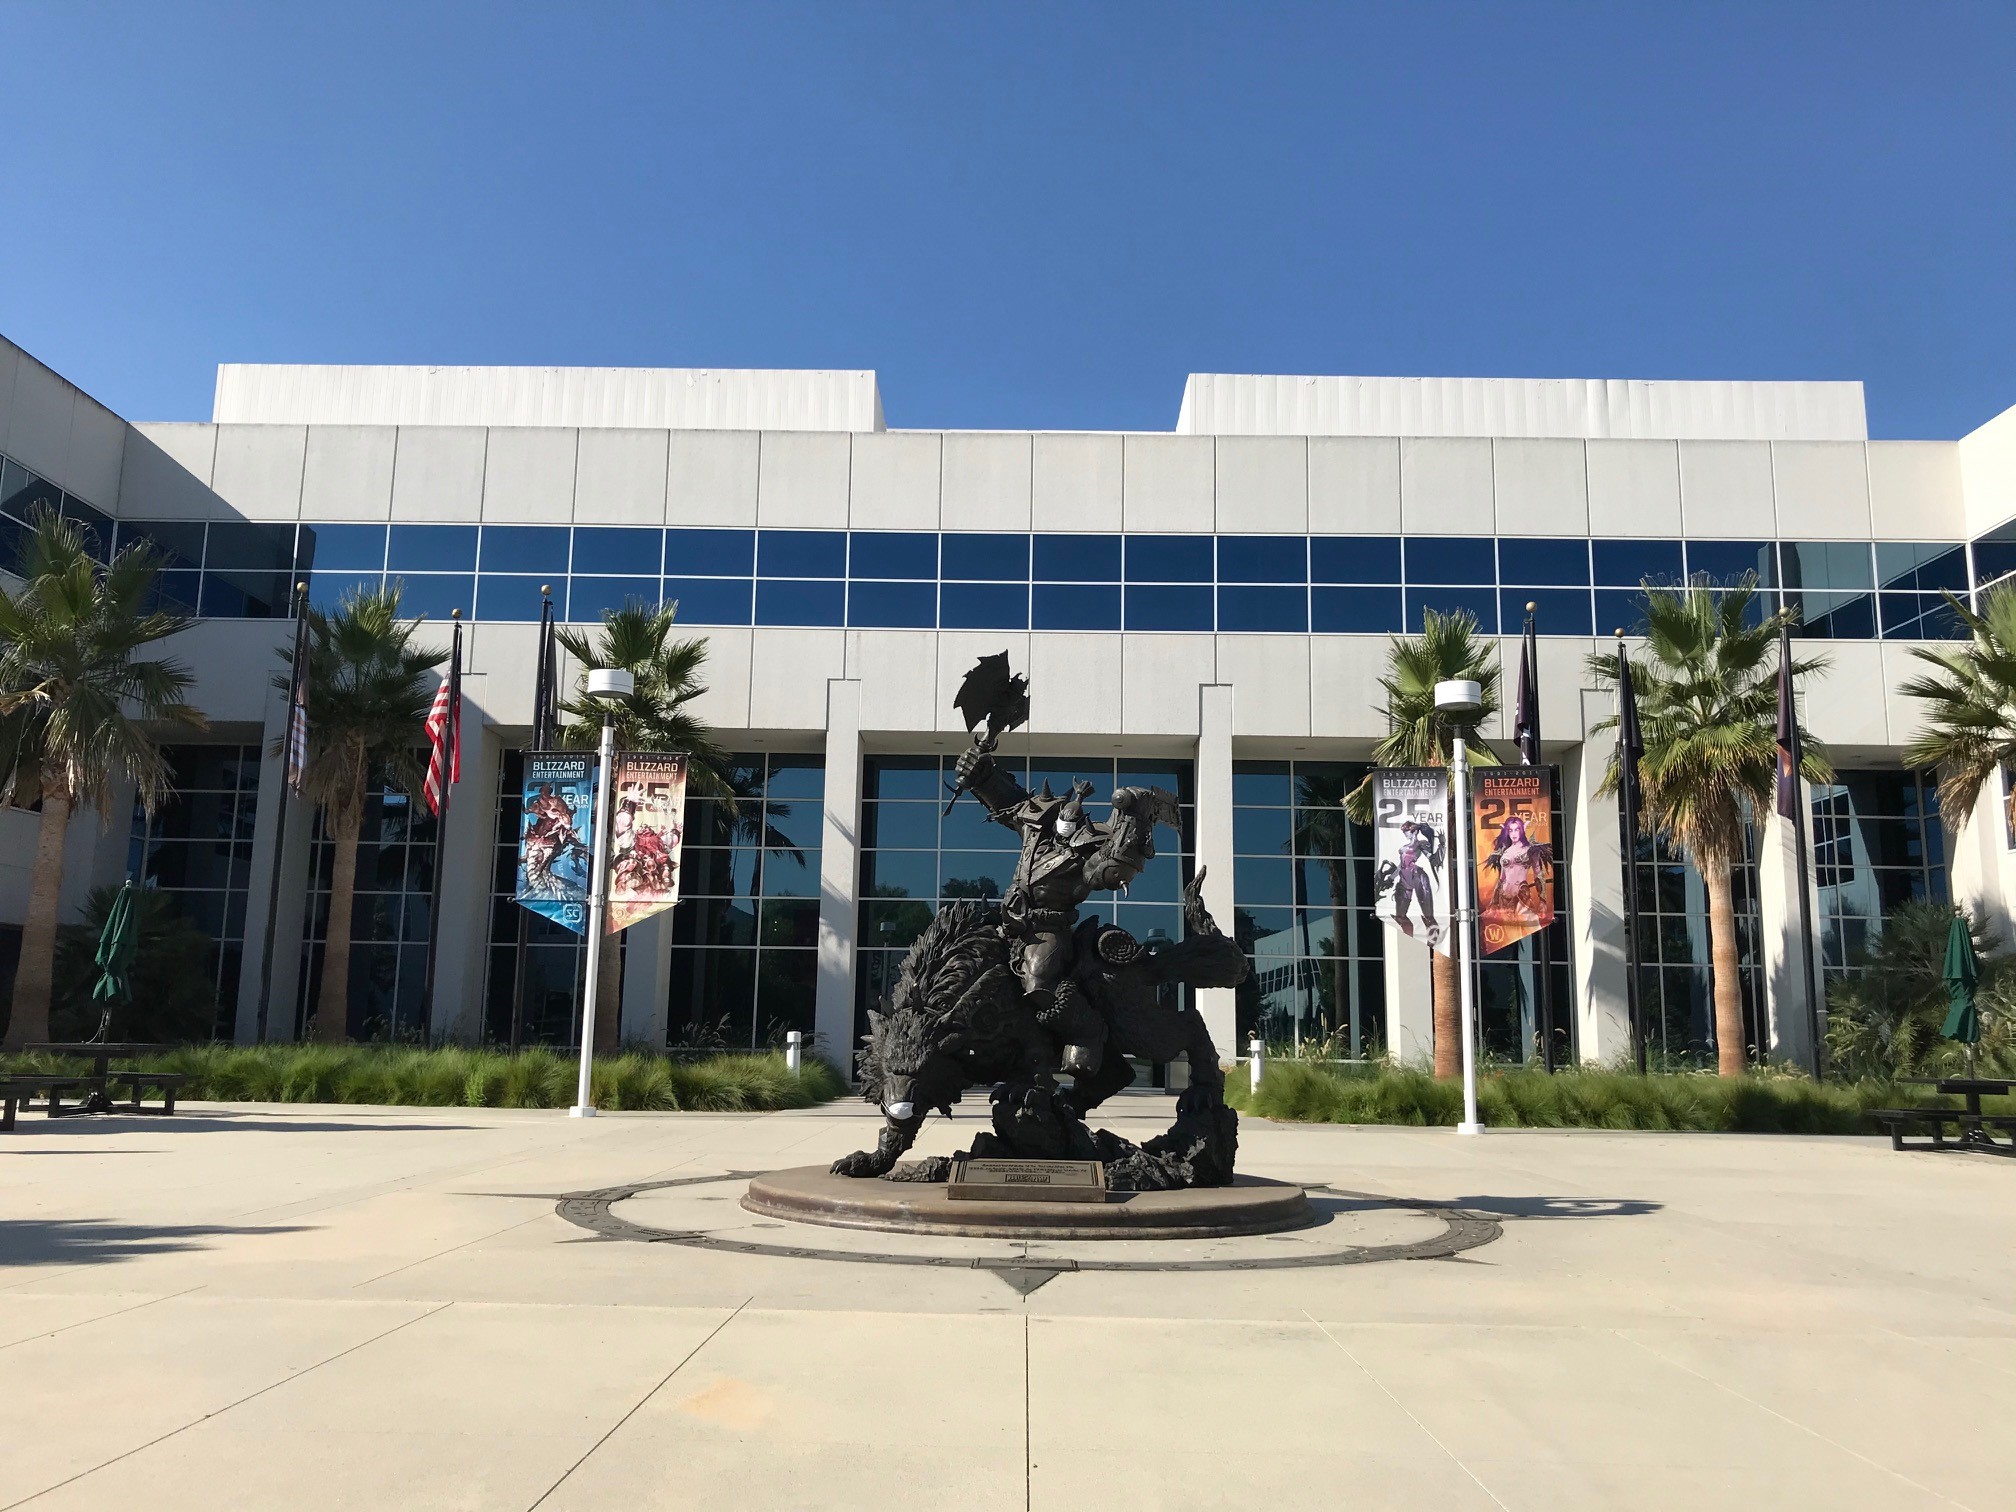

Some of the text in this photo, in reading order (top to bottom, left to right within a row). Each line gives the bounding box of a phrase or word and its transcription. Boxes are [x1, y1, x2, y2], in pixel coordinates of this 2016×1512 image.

[533, 761, 585, 771] BLIZZARD
[626, 761, 679, 772] BLIZZARD
[532, 770, 585, 779] ENTERTAINMENT
[626, 771, 678, 780] ENTERTAINMENT
[1383, 778, 1437, 788] BLIZZARD
[1484, 777, 1540, 788] BLIZZARD
[1383, 788, 1437, 797] ENTERTAINMENT
[1484, 787, 1540, 796] ENTERTAINMENT
[1411, 812, 1443, 823] YEAR
[1514, 811, 1547, 822] YEAR
